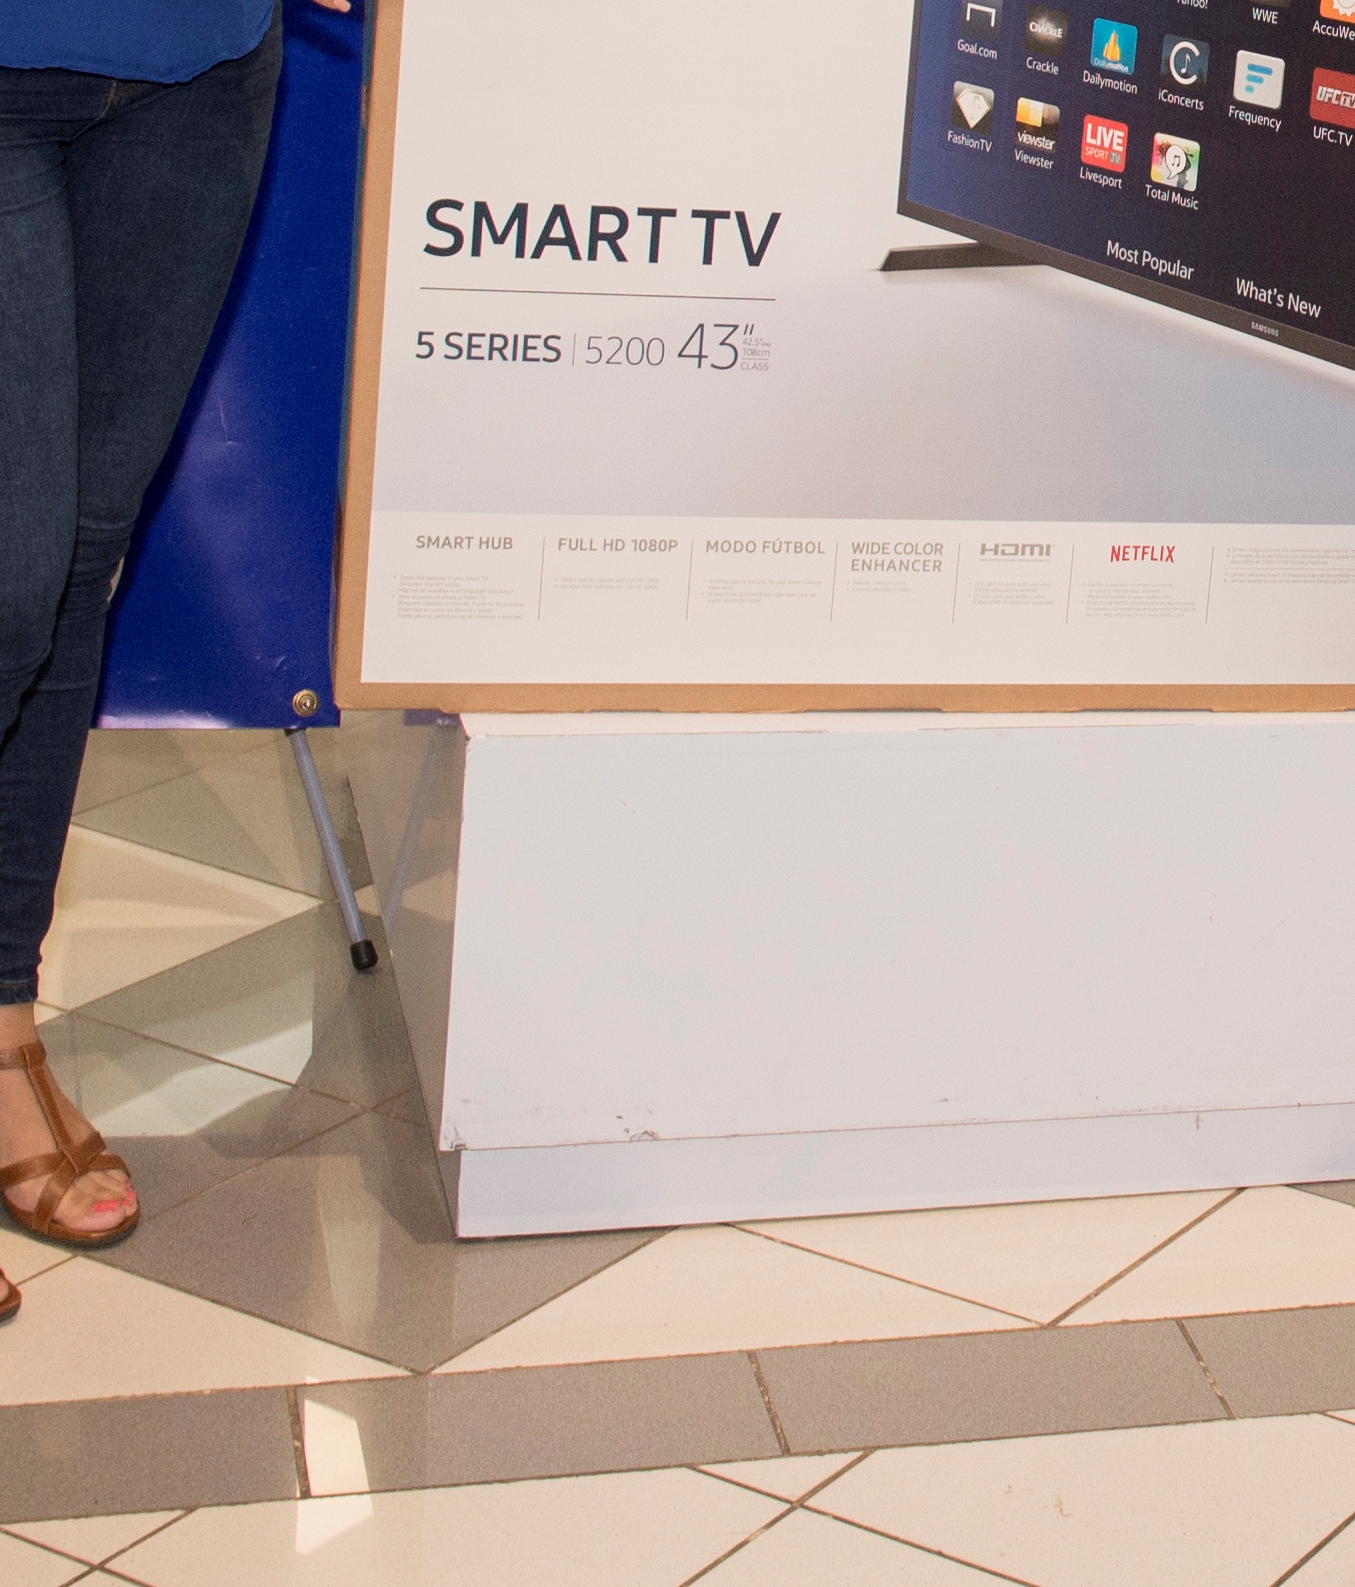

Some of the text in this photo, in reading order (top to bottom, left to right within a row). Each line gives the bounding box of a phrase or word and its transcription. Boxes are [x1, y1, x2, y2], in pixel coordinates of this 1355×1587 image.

[1252, 7, 1278, 24] WWE
[956, 39, 998, 60] Goal.com
[1026, 57, 1059, 76] Crackle
[1083, 70, 1138, 94] Dailymotion
[1158, 88, 1204, 110] iConcerts
[1228, 106, 1282, 132] Frequency
[947, 131, 992, 153] FashionTV
[1017, 130, 1056, 151] viewster
[1086, 123, 1124, 151] LIVE
[1313, 126, 1353, 147] UFC.TV
[1014, 150, 1054, 171] Viewster
[1079, 167, 1123, 189] Livesport
[1145, 185, 1199, 210] Total Music
[422, 198, 782, 268] SMART TV
[1106, 239, 1195, 282] Most Popular
[1235, 277, 1321, 320] What's New
[415, 332, 435, 361] 5
[444, 332, 562, 364] SERIES
[585, 335, 665, 367] 5200
[740, 362, 769, 371] CLASS
[415, 534, 514, 551] SMART HUB
[557, 537, 679, 553] FULL HD 1080P
[705, 538, 826, 555] MODO FÚTBOL
[851, 541, 943, 556] WIDE COLOR
[980, 543, 1051, 556] HDMI
[1110, 545, 1176, 563] NETFLIX
[851, 559, 942, 572] ENHANCER
